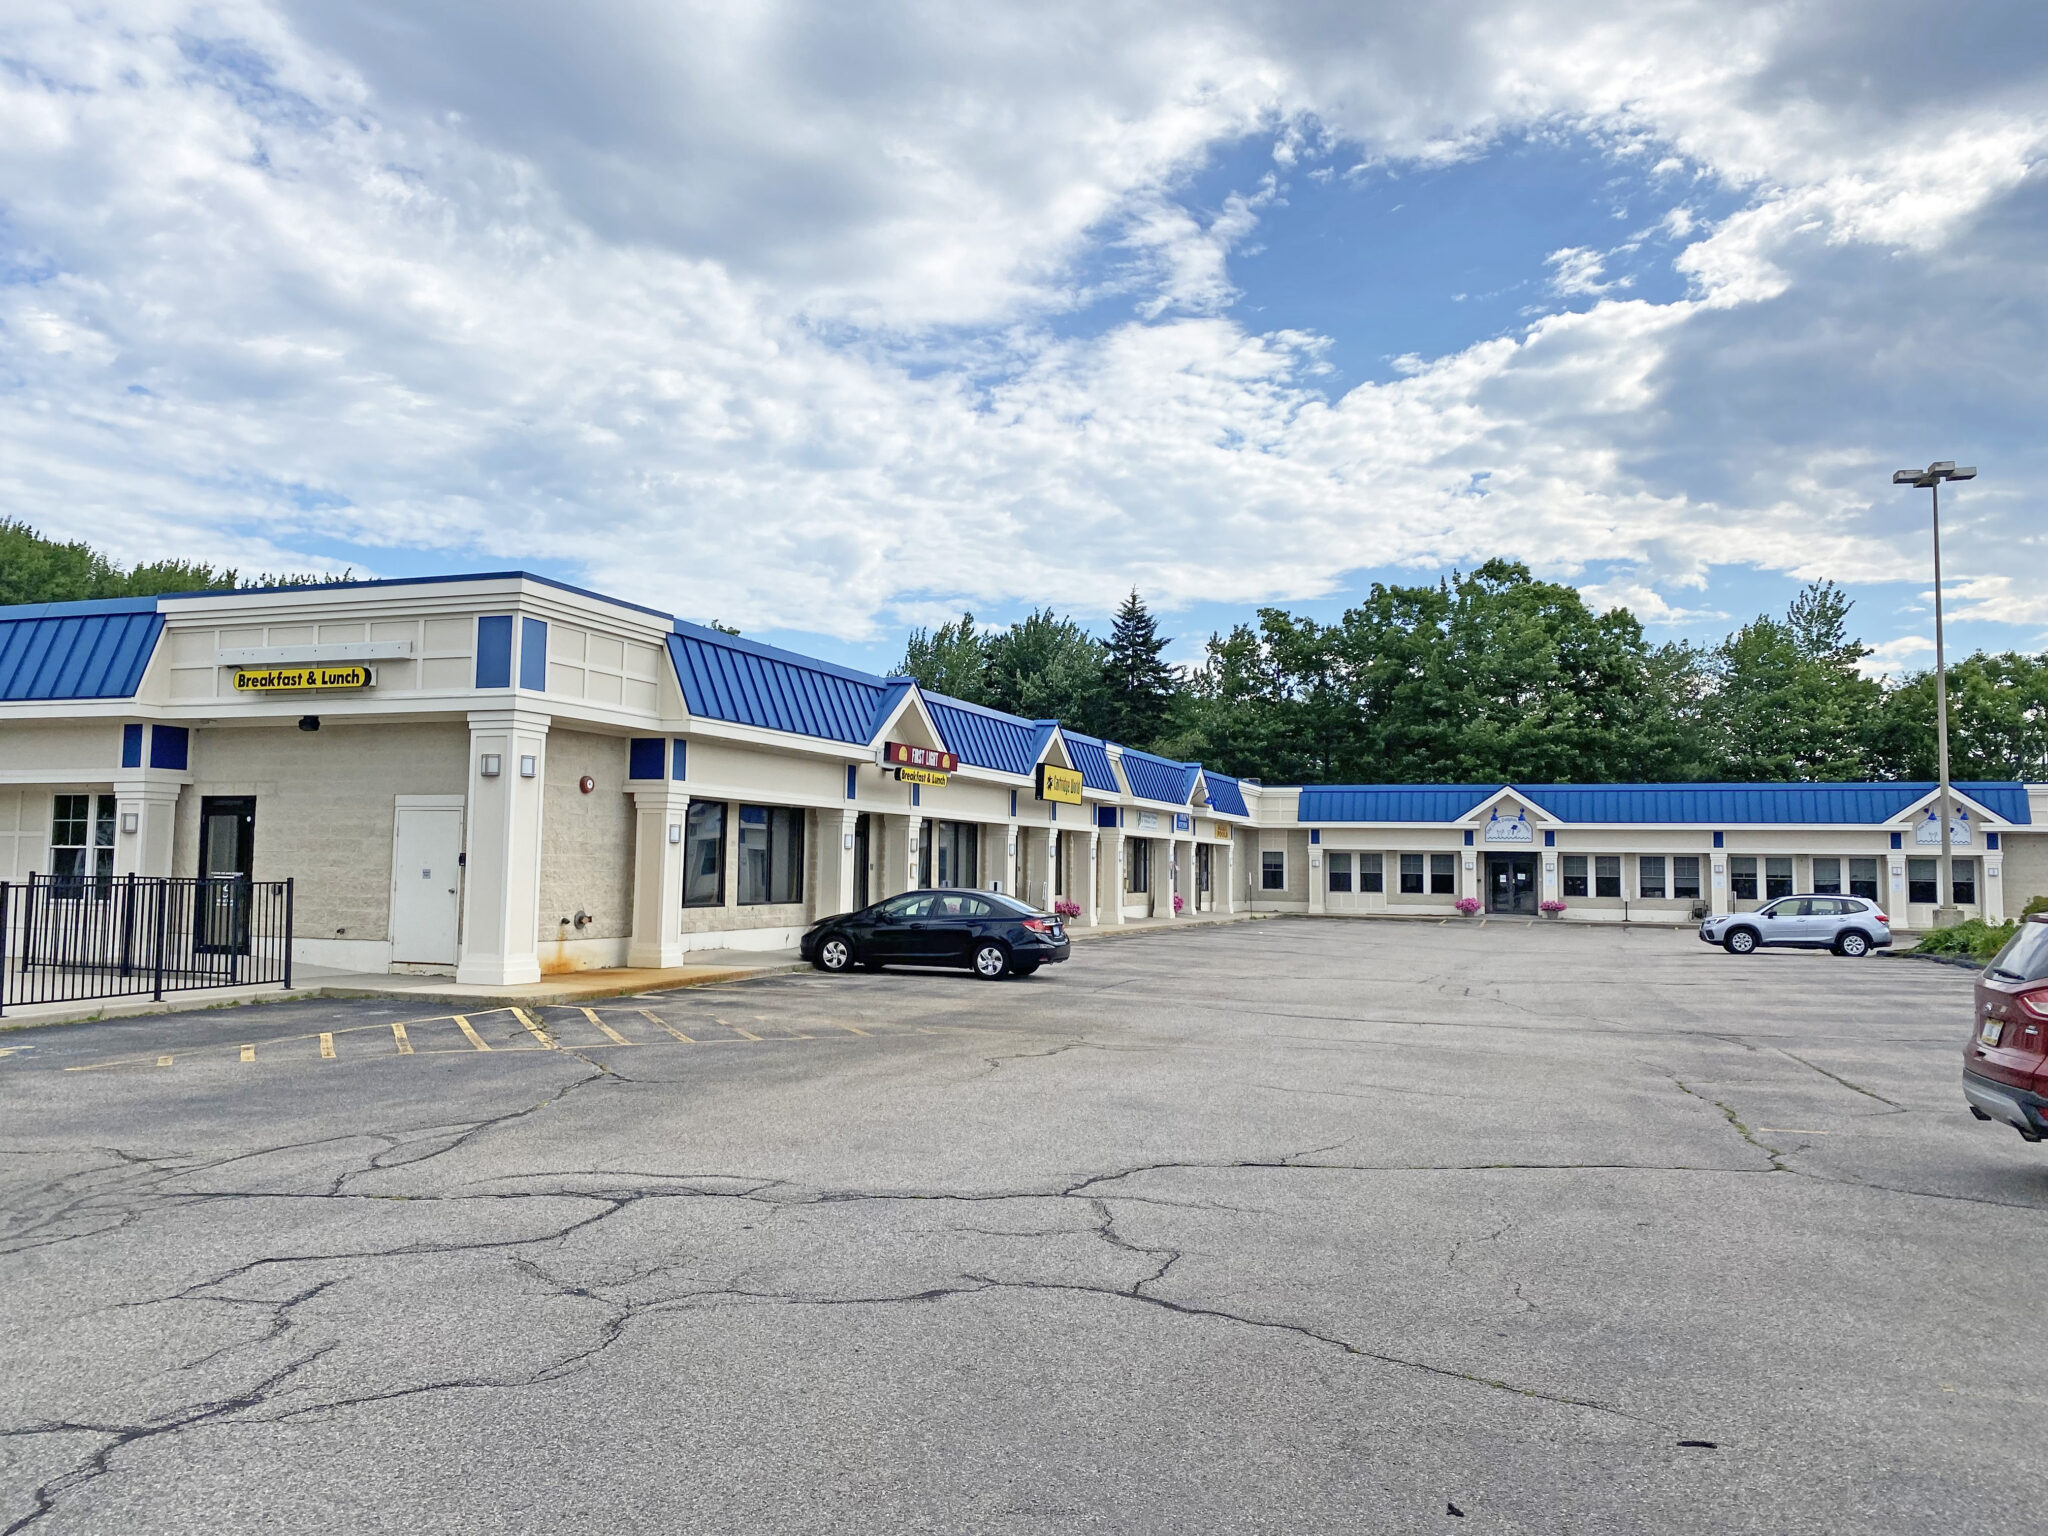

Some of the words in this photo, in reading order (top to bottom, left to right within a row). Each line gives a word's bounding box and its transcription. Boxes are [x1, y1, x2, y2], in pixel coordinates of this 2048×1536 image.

[238, 671, 302, 688] Breakfast
[306, 671, 317, 685] &
[321, 669, 360, 685] Lunch
[911, 748, 925, 765] FIRST
[926, 750, 939, 767] LIGHT
[902, 769, 926, 783] Breakfast
[932, 773, 946, 785] Lunch
